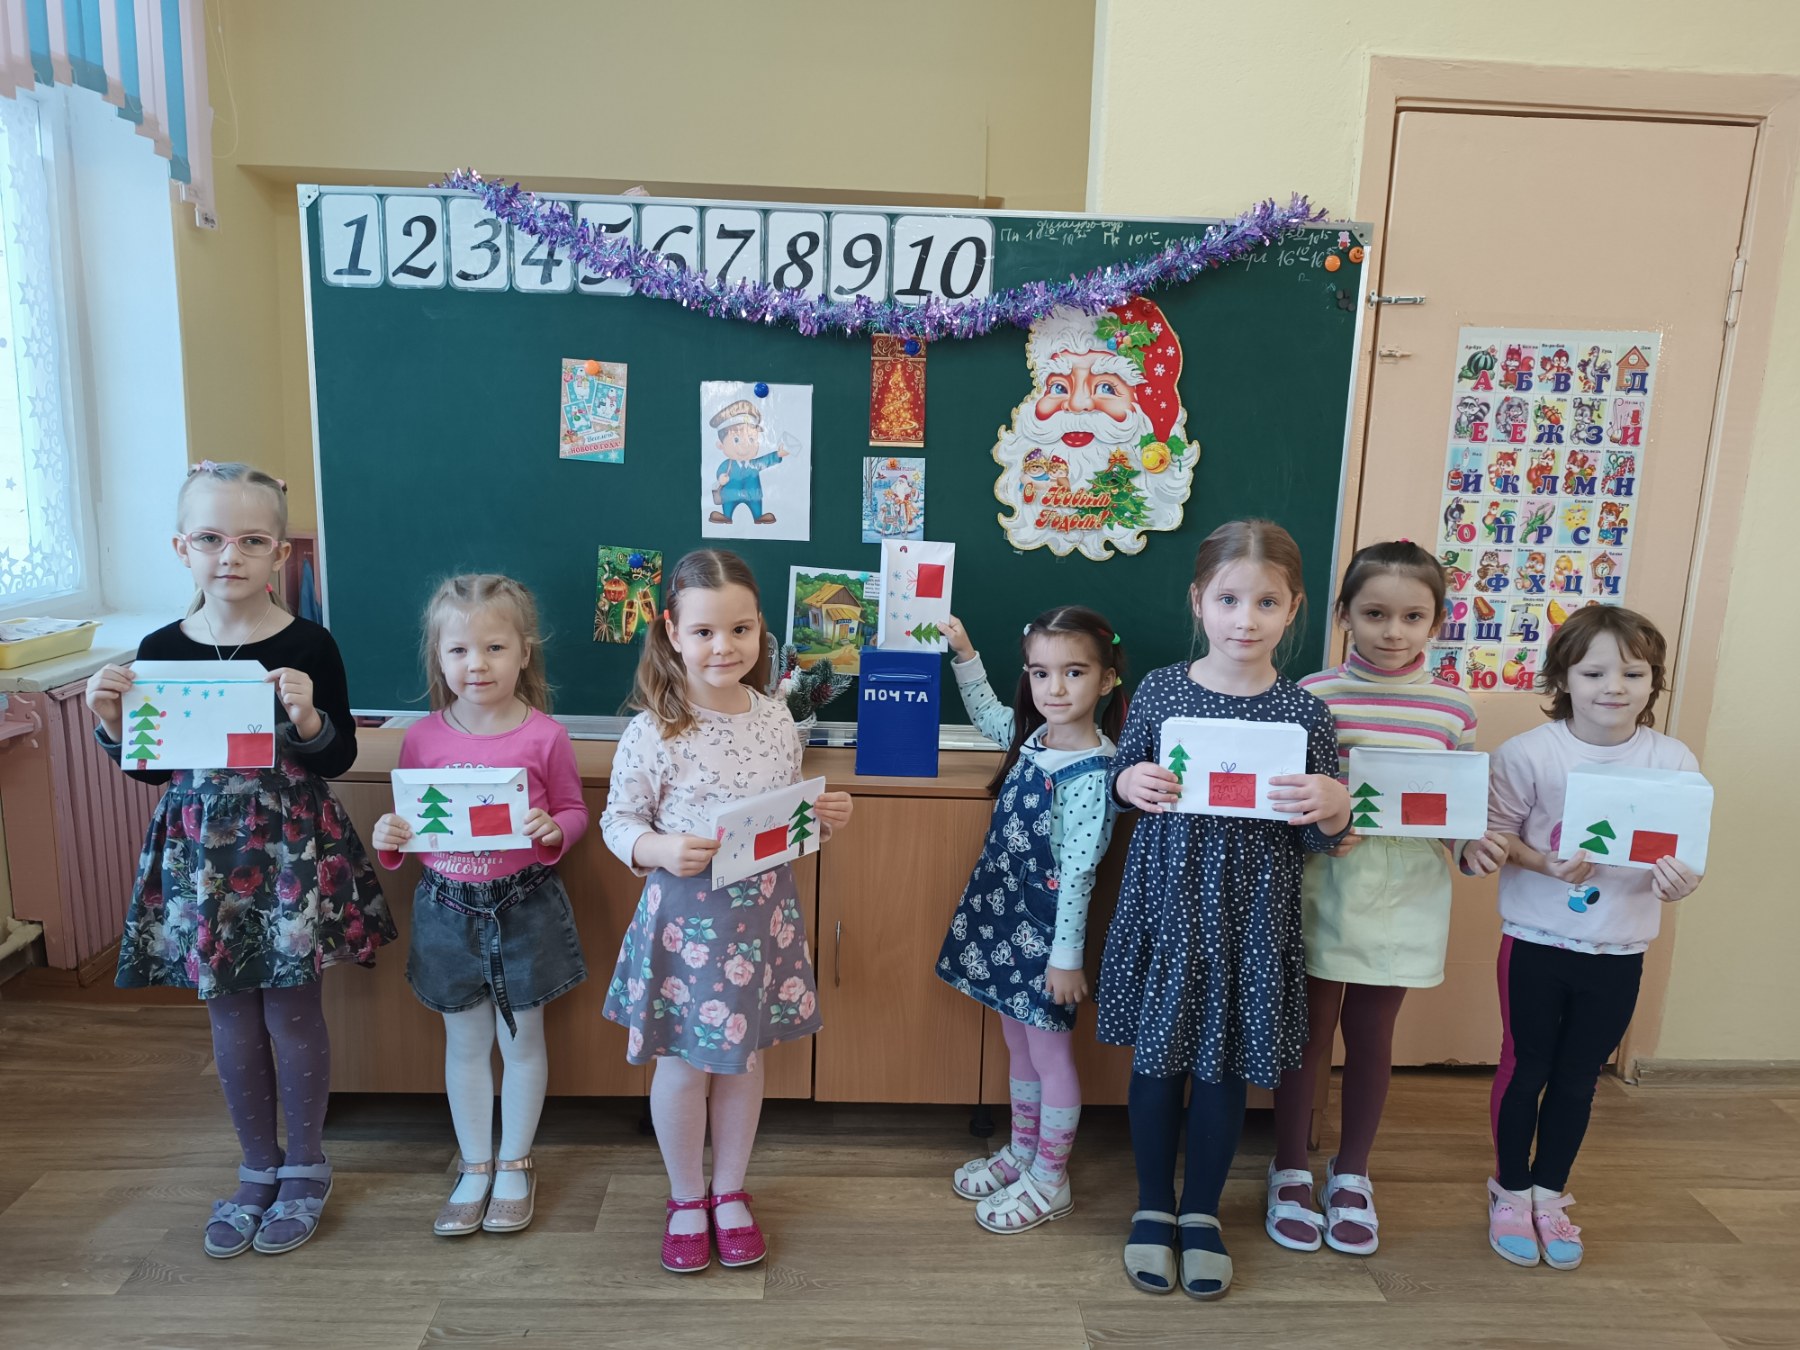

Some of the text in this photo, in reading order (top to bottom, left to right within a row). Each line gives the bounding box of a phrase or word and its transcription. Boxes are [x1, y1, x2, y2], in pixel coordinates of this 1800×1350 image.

[333, 214, 372, 276] 1
[392, 215, 437, 279] 2
[456, 217, 502, 281] 3
[521, 233, 563, 285] 4
[716, 223, 755, 290] 7
[773, 231, 820, 292] 8
[834, 233, 882, 295] 9
[895, 235, 987, 299] 10
[1472, 370, 1648, 394] А Б В Г Д
[1471, 422, 1488, 442] Е
[1535, 424, 1564, 443] Ж
[1585, 425, 1603, 444] З
[1619, 426, 1642, 445] И
[1460, 469, 1635, 495] Й К Л М Н
[1041, 485, 1112, 508] Новым
[1457, 524, 1628, 545] О П Р С Т
[1453, 572, 1621, 595] У Ф Х Ц Ч
[1438, 623, 1539, 642] Ш Щ Ъ
[1443, 670, 1535, 690] Э Ю Я
[864, 689, 928, 702] ПОЧТА
[433, 859, 490, 876] unicorn
